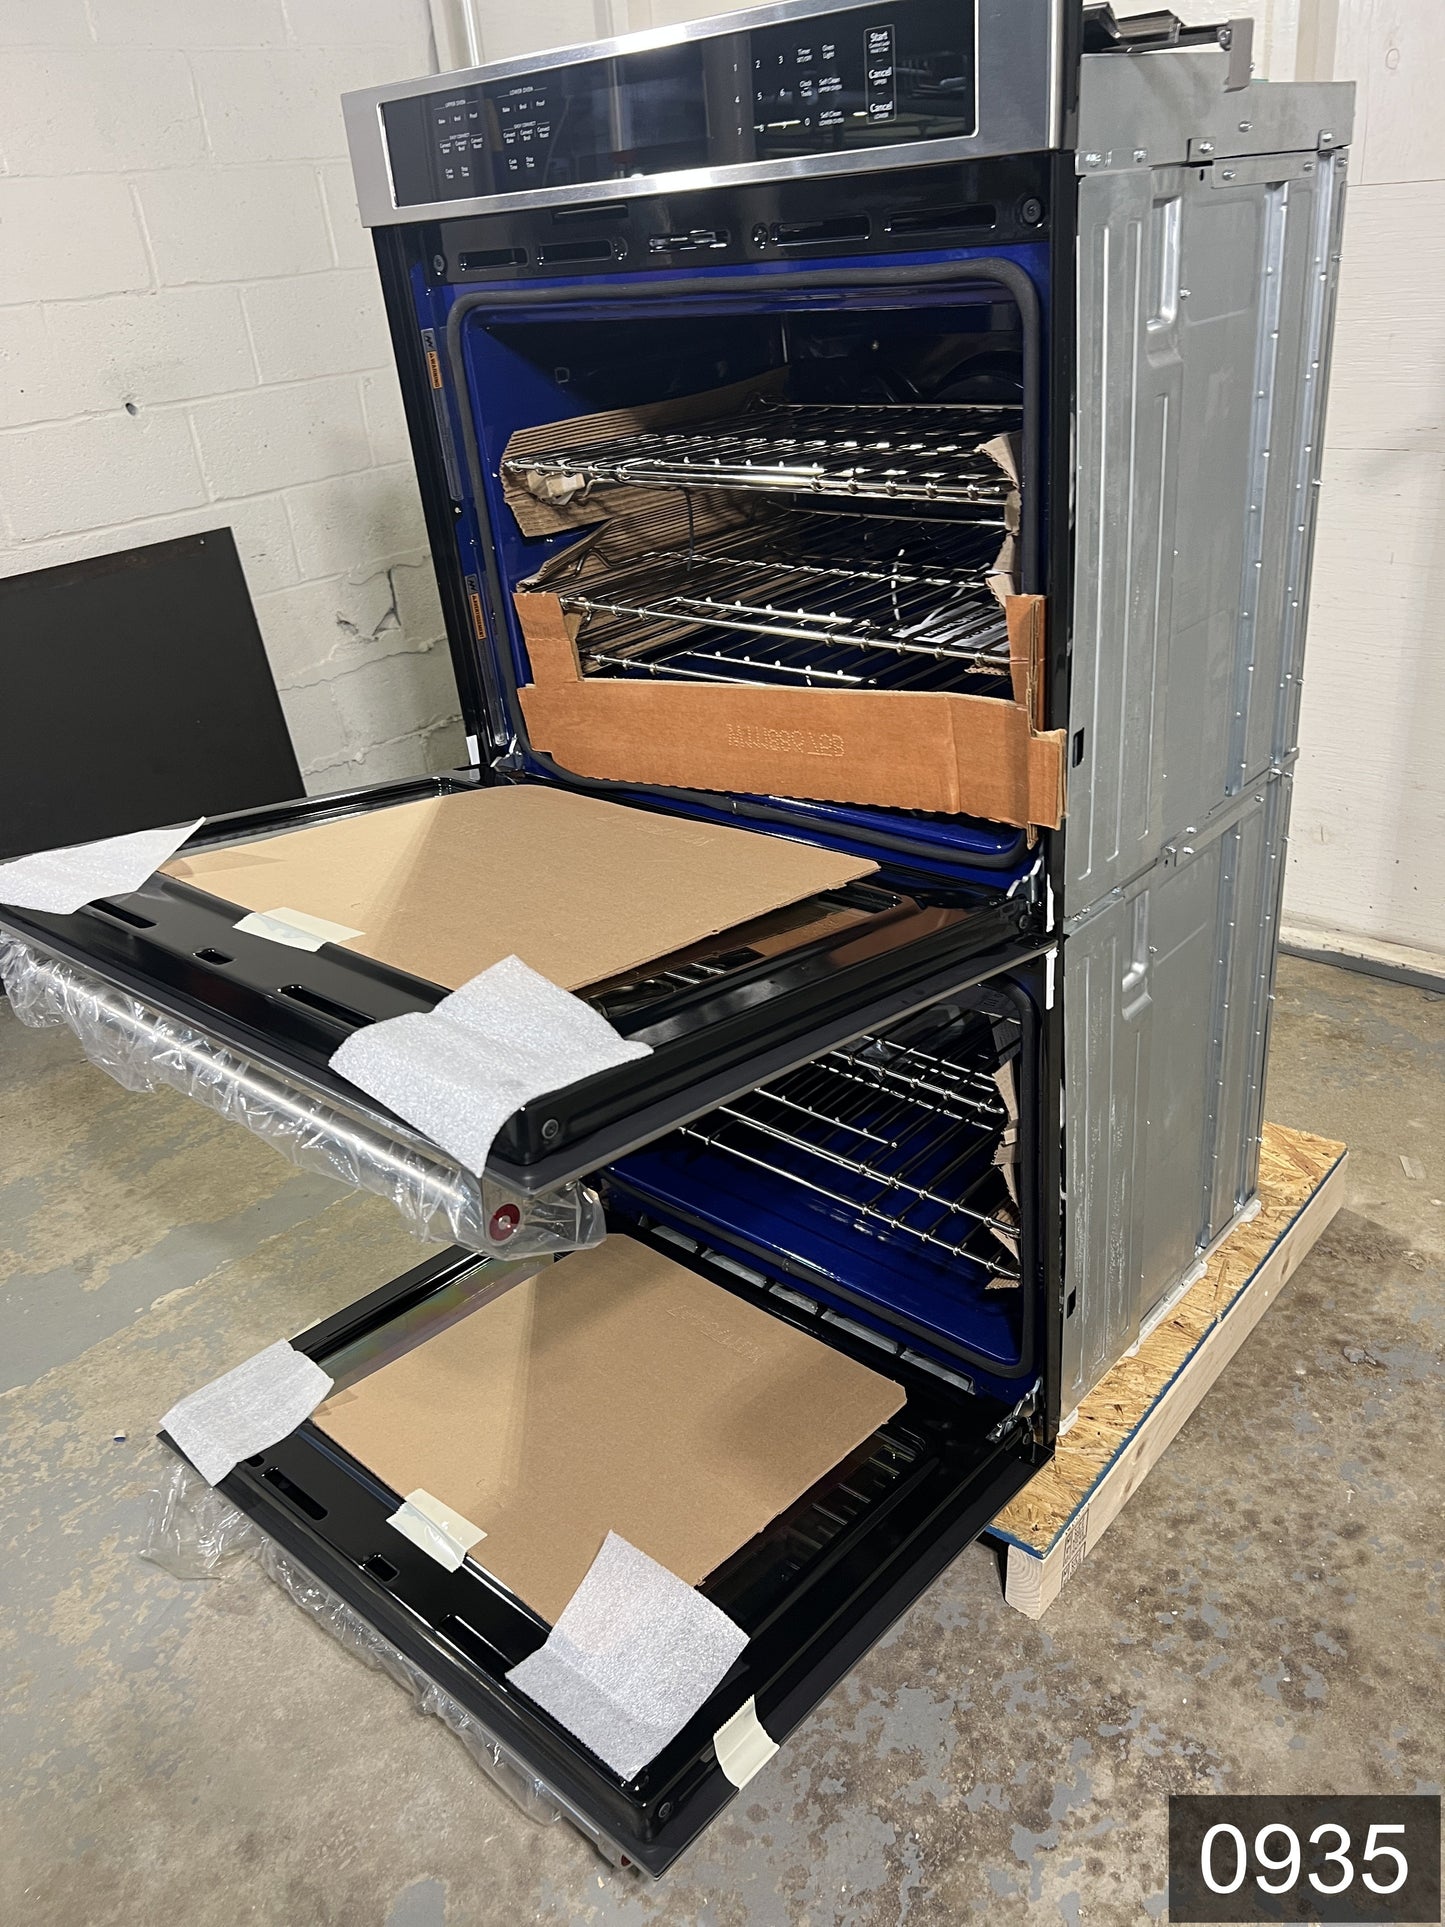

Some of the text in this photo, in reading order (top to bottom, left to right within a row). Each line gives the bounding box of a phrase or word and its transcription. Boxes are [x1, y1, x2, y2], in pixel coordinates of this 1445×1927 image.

[870, 30, 888, 42] Start
[756, 60, 760, 68] 2
[778, 56, 784, 64] 3
[868, 66, 892, 80] Cancel
[757, 92, 762, 100] 5
[780, 88, 785, 96] 6
[870, 100, 893, 113] Cancel
[804, 118, 810, 126] 0
[430, 358, 441, 388] WARNING
